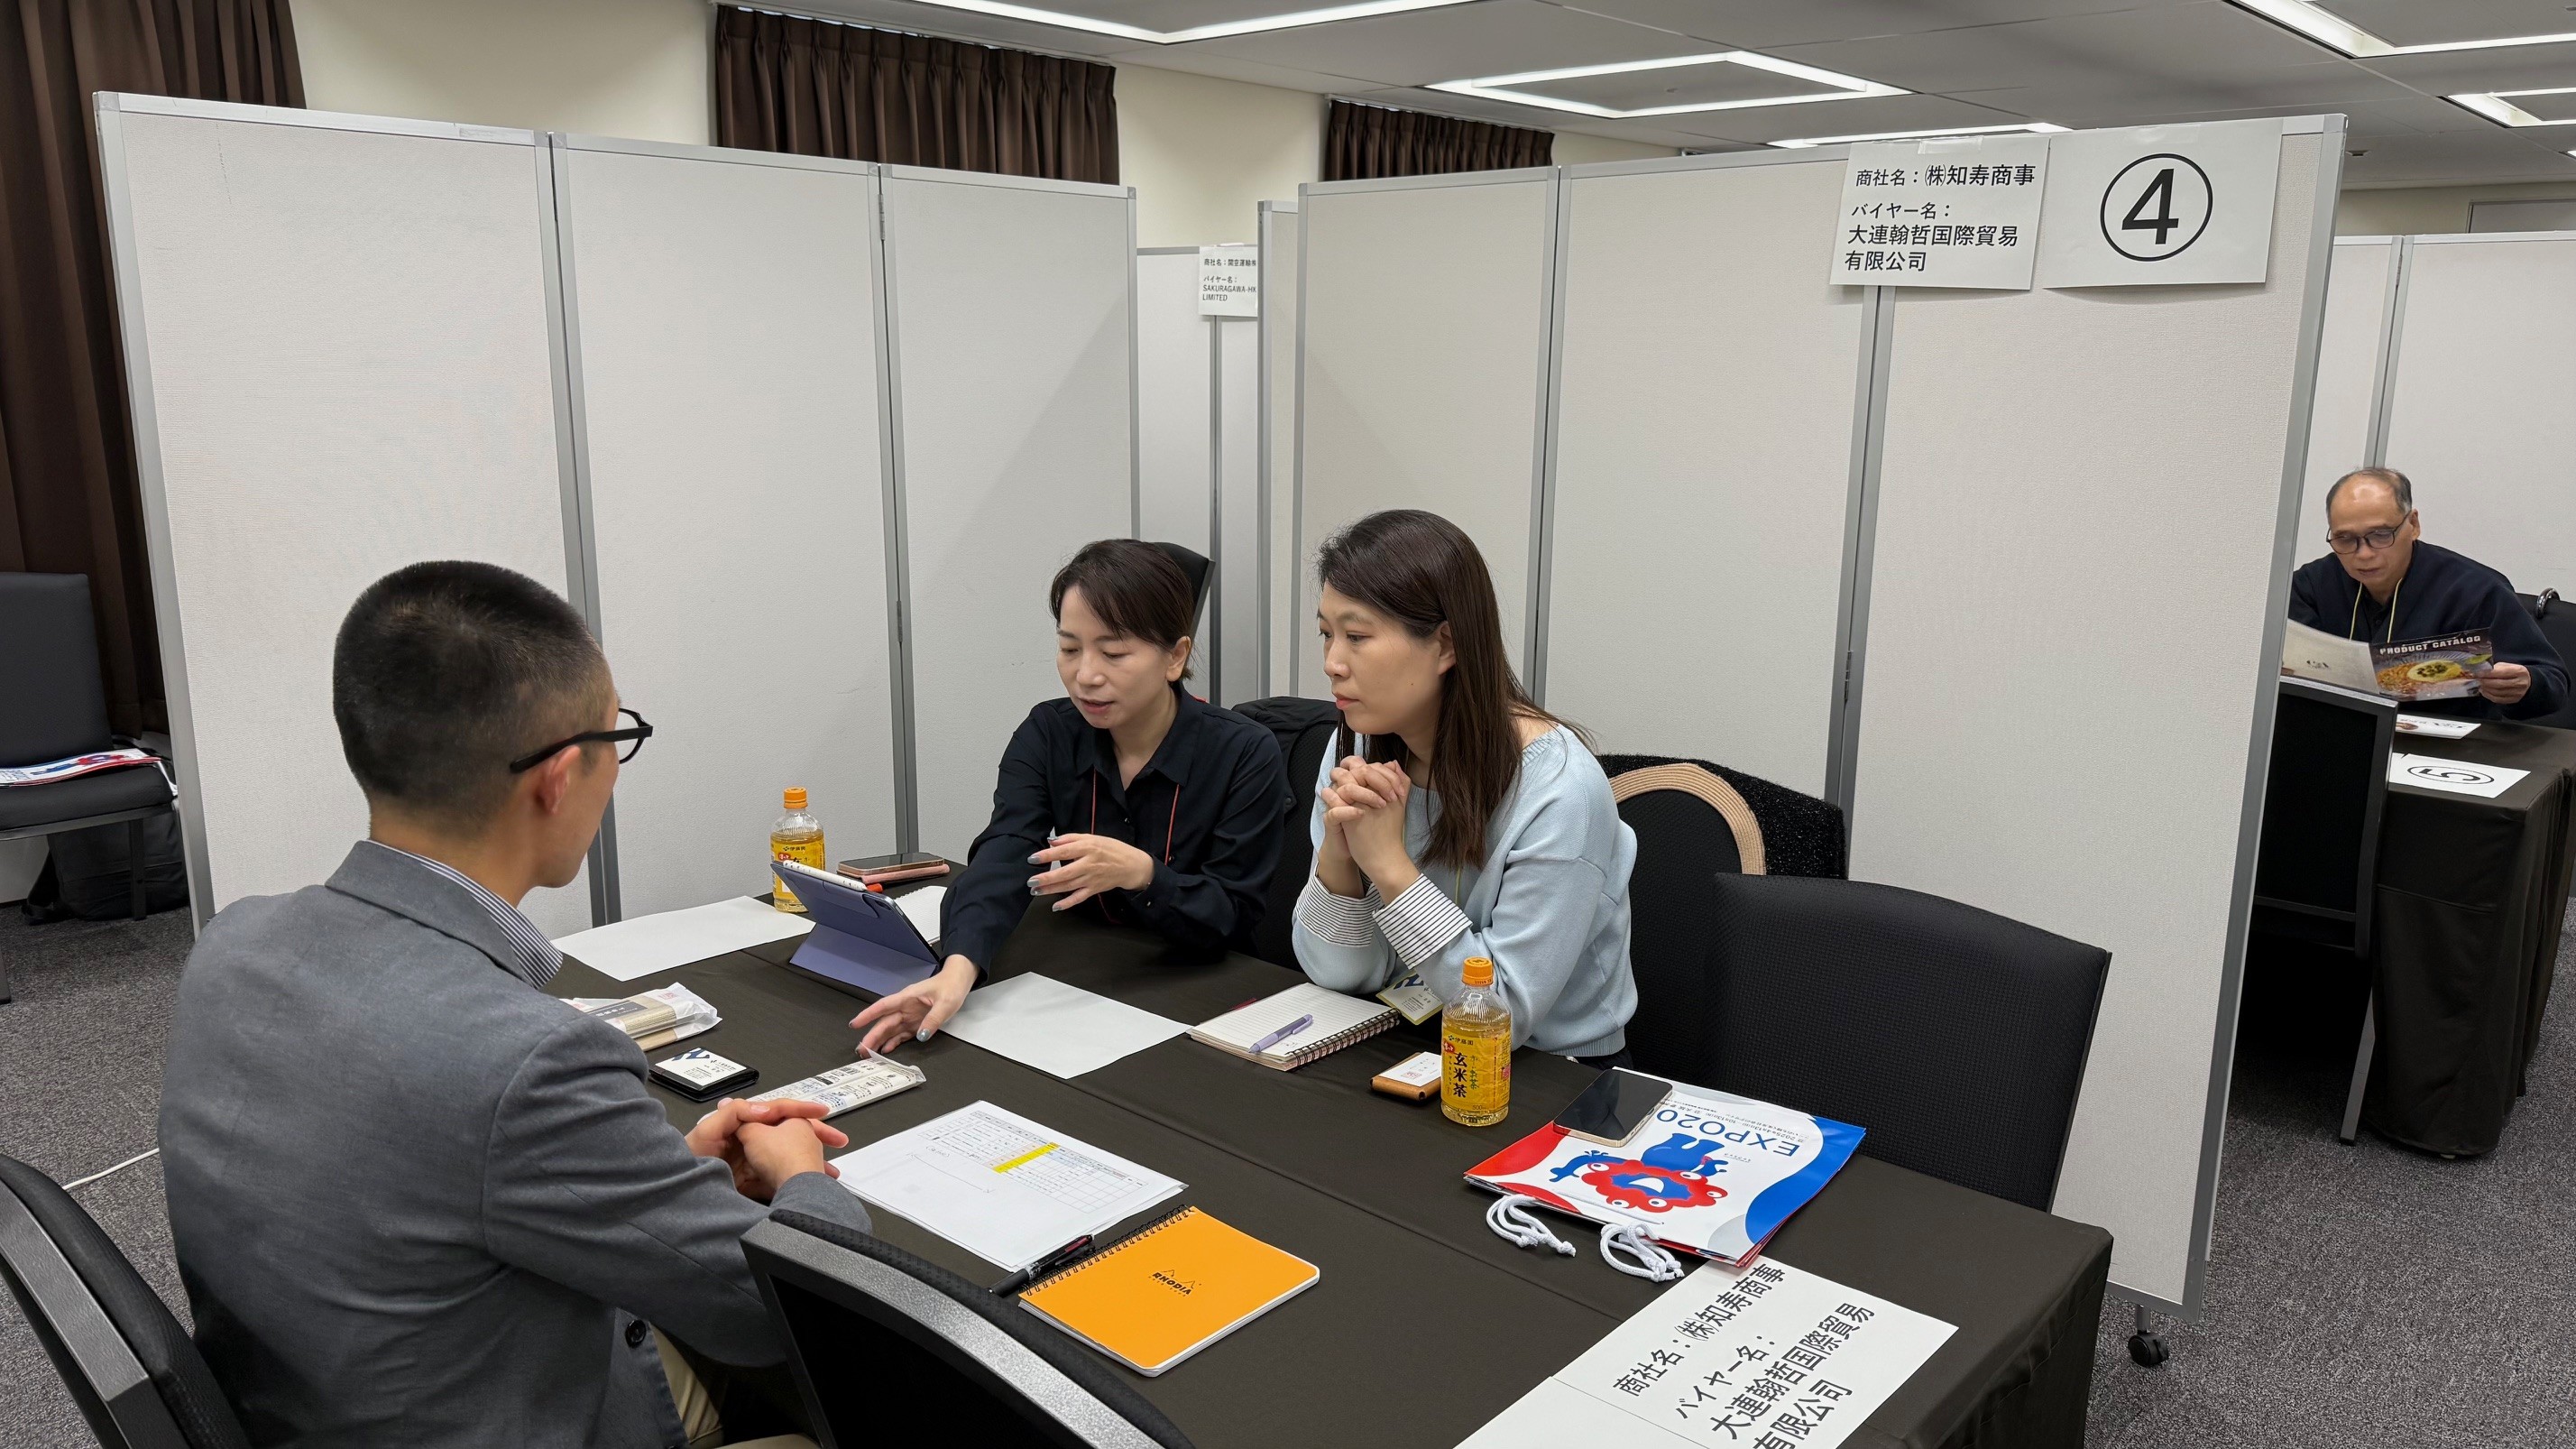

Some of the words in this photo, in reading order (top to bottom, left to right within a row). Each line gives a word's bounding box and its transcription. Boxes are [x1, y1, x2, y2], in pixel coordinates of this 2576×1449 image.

[1847, 224, 2019, 247] 大連翰哲国際貿易
[1845, 250, 1927, 272] 有限公司
[2379, 643, 2429, 656] PRODUCT
[2433, 635, 2481, 649] CATALOG
[1453, 1052, 1467, 1098] 玄米茶
[1153, 1272, 1191, 1295] RHODIA
[1709, 1302, 1875, 1440] 大連翰哲国際貿易
